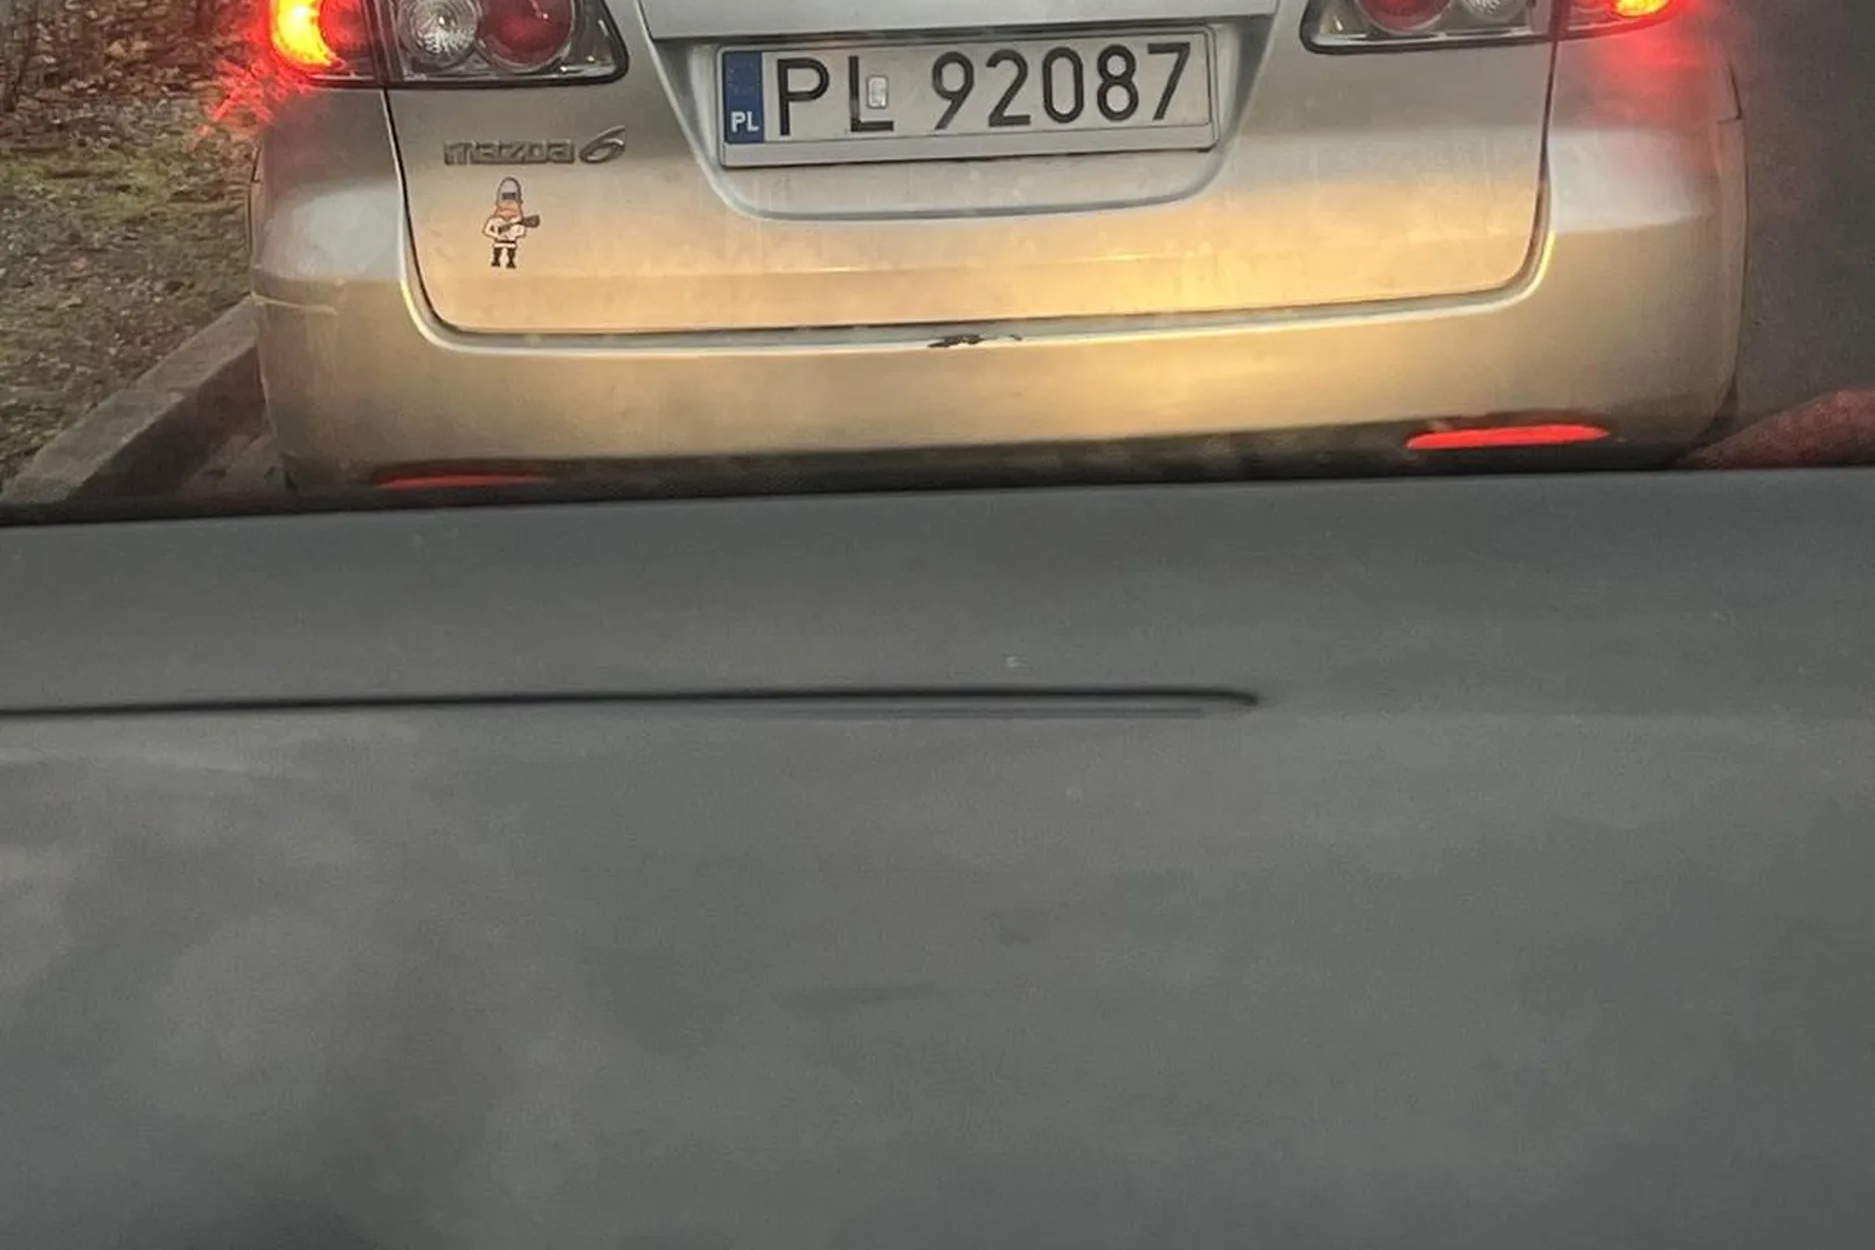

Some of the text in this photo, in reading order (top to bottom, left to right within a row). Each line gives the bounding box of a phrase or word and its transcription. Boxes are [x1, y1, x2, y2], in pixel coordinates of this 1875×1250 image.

[776, 41, 1192, 137] PL 92087
[731, 110, 760, 132] PL
